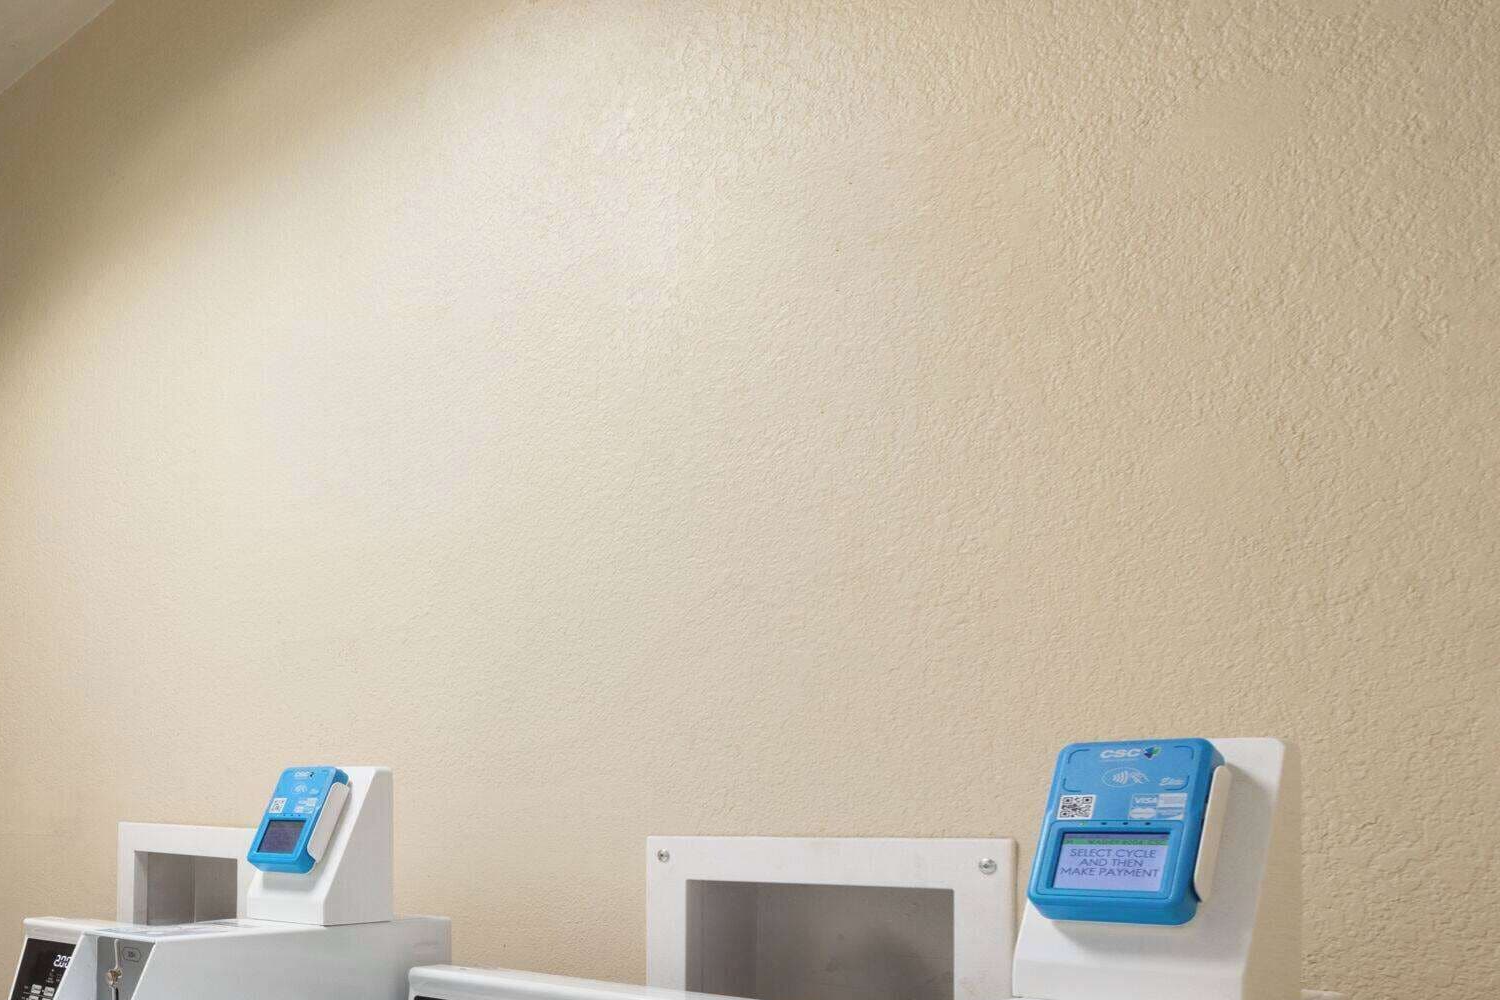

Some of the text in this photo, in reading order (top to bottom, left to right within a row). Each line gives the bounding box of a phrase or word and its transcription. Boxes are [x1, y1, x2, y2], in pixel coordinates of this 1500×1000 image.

[1100, 748, 1141, 759] CSC
[1070, 848, 1157, 859] SELECT CYCLE
[1079, 858, 1144, 868] AND THEN
[1060, 867, 1159, 878] MAKE PAYMENT
